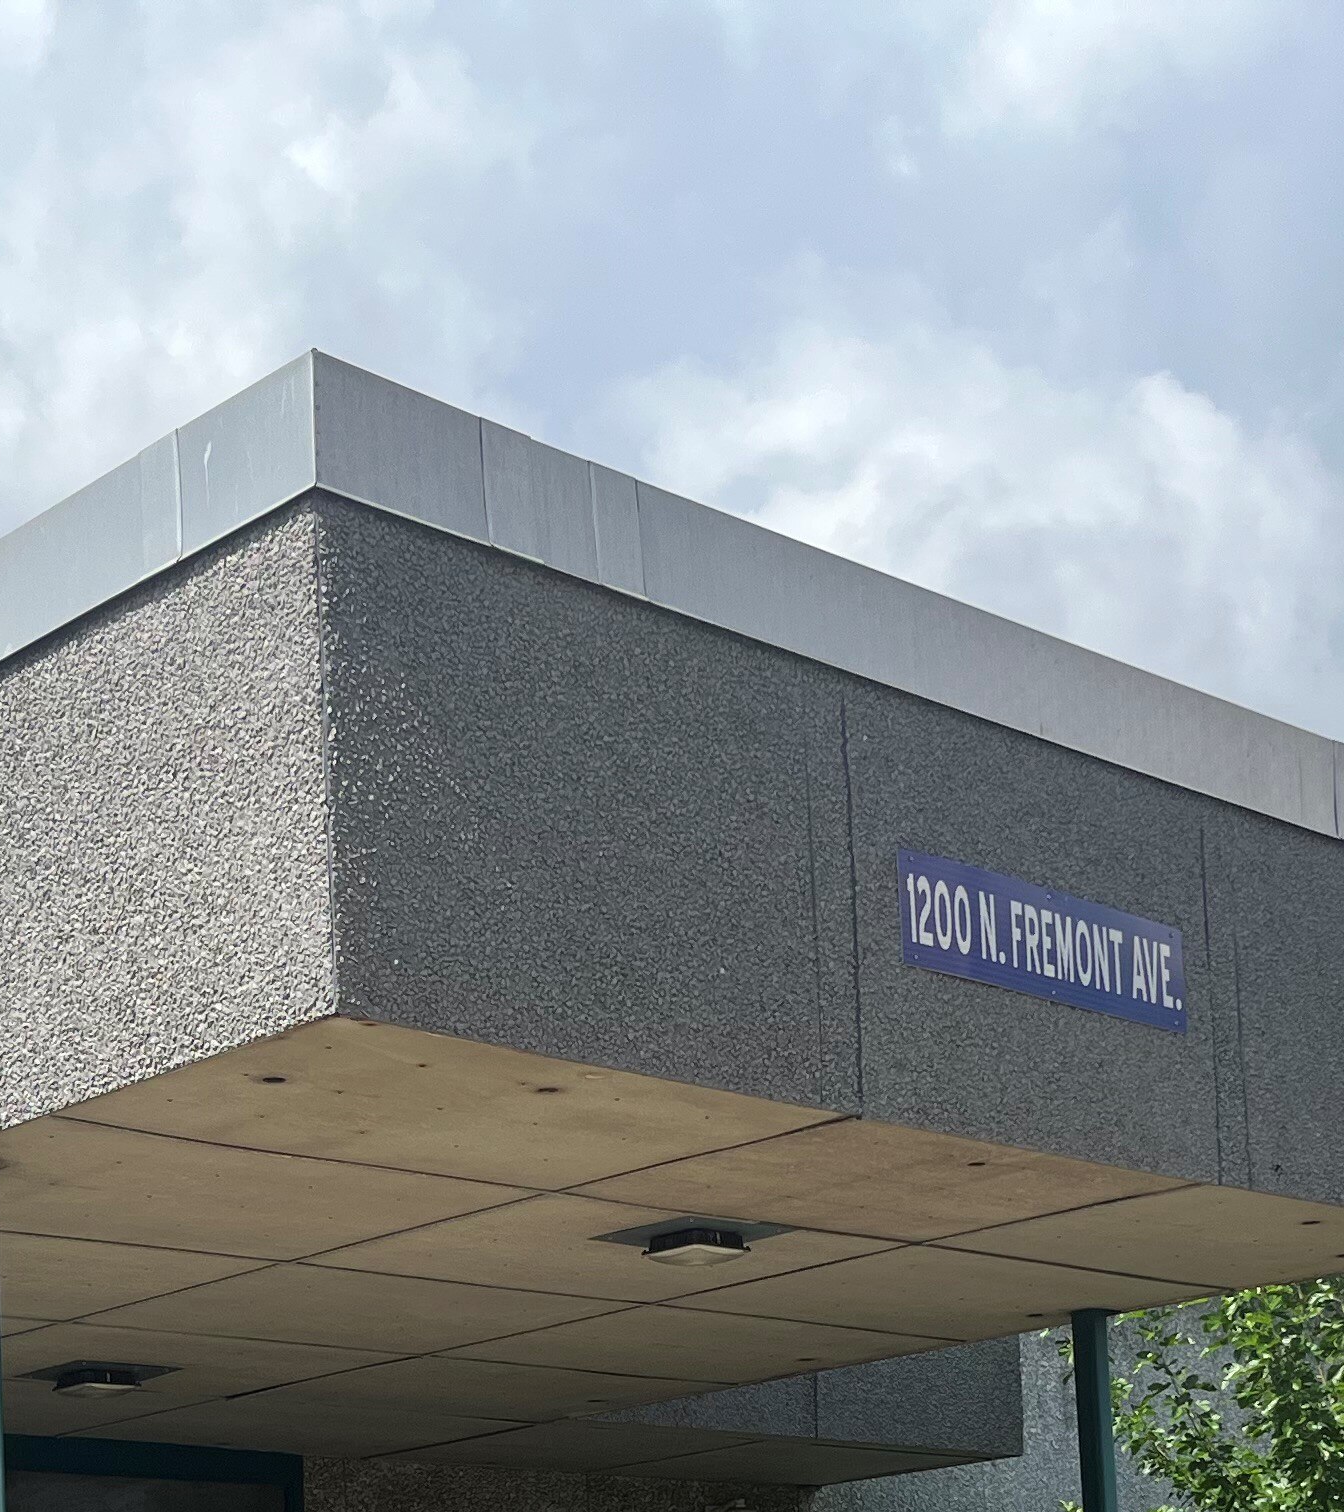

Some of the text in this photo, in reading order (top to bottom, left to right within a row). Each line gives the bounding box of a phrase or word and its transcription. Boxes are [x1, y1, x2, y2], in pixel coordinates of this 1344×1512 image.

[907, 873, 1183, 1011] 1200 N. FREMONT AVE.
